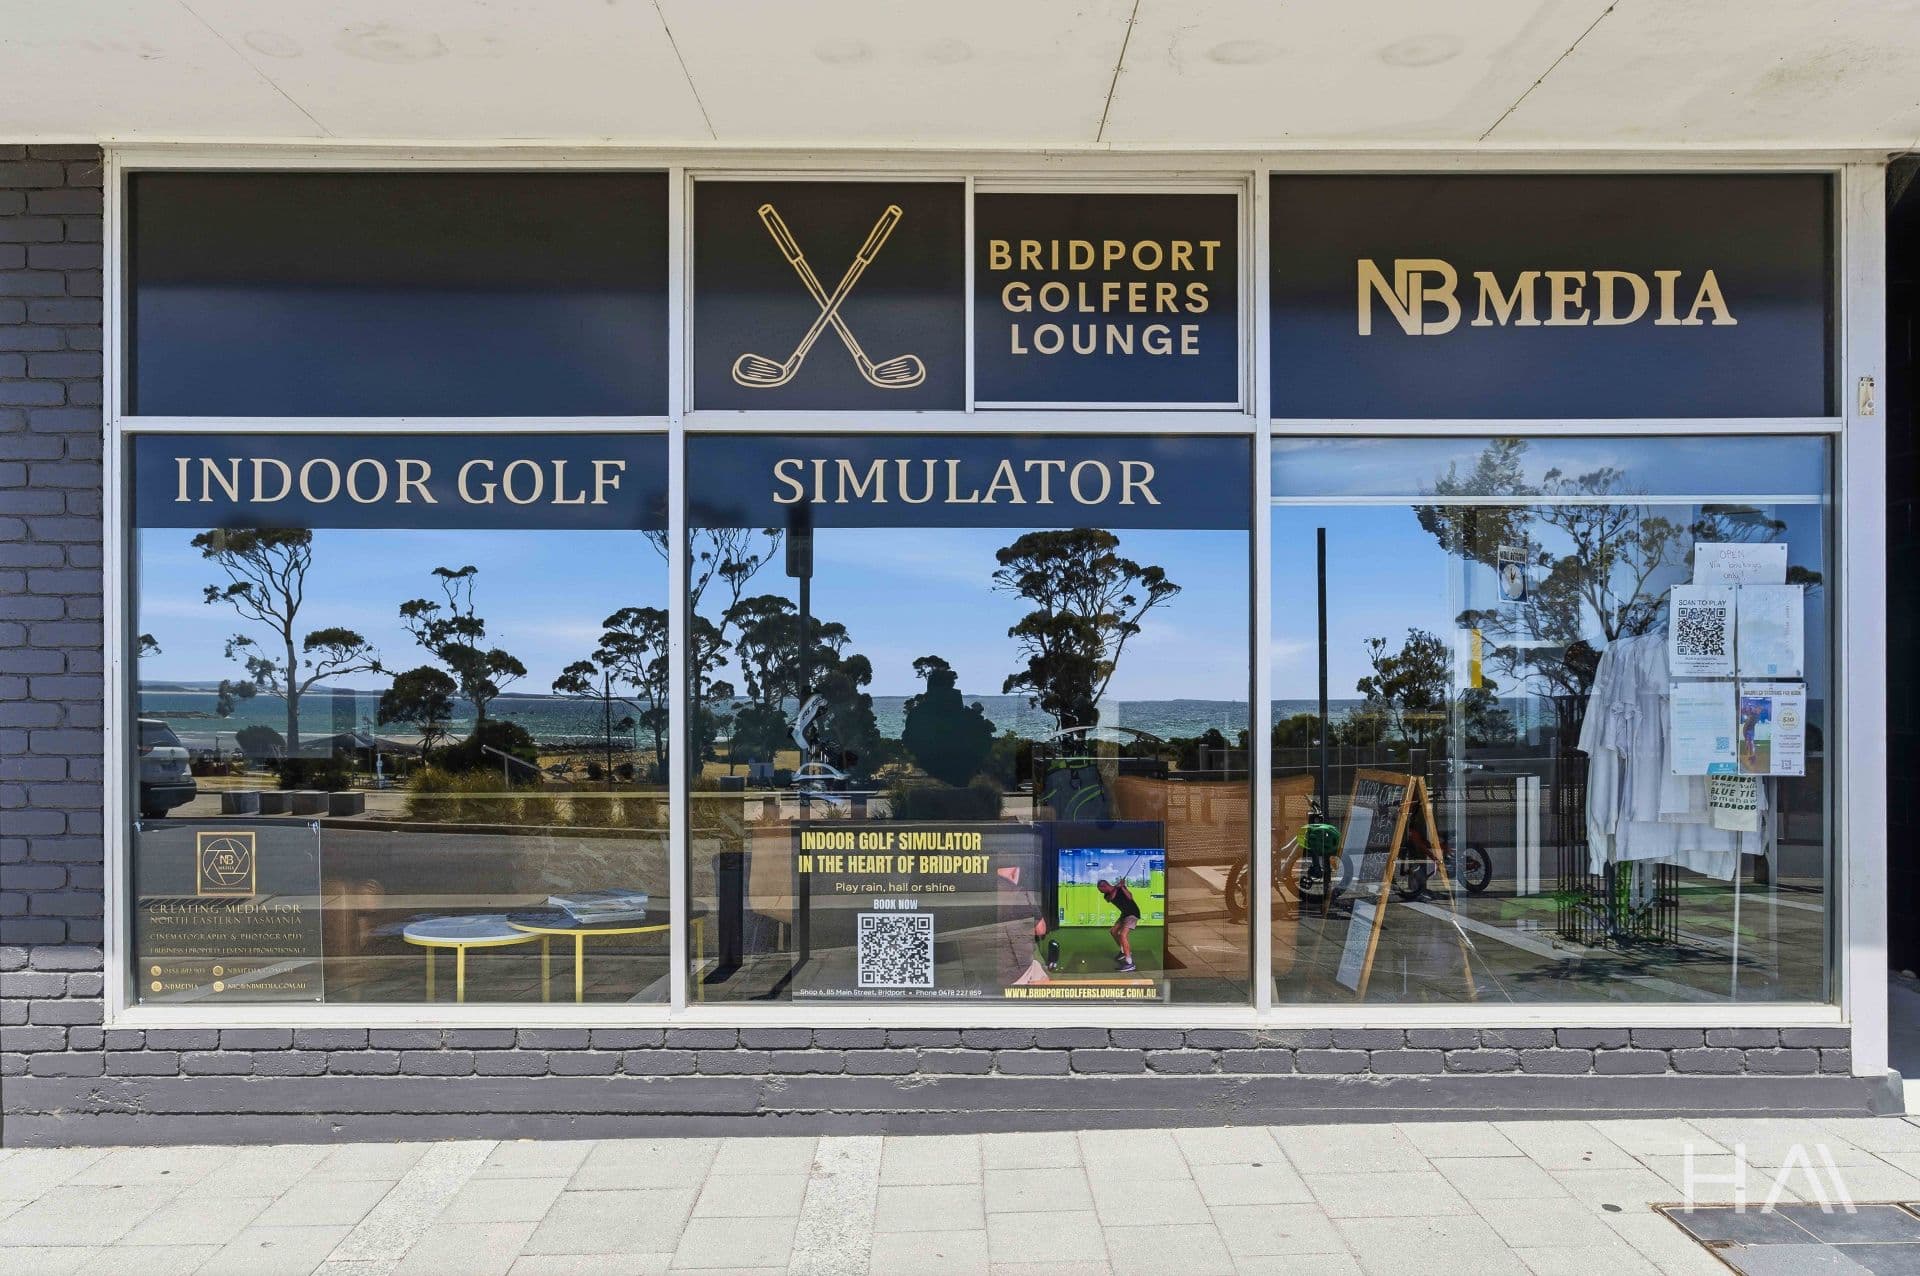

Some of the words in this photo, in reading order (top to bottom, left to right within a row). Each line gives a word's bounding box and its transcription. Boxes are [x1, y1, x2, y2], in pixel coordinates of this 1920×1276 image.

[989, 239, 1221, 271] BRIDPORT
[1001, 281, 1210, 313] GOLFERS
[1357, 258, 1462, 336] NB
[1470, 269, 1738, 327] MEDIA
[1010, 323, 1200, 355] LOUNGE
[174, 457, 438, 504] INDOOR
[457, 458, 627, 505] GOLF
[772, 457, 1161, 505] SIMULATOR
[1719, 550, 1744, 560] OPEN
[1711, 787, 1736, 797] BLUE
[1740, 790, 1756, 798] TIE
[801, 832, 855, 850] INDOOR
[859, 832, 895, 850] GOLF
[899, 832, 982, 851] SIMULATOR
[219, 854, 234, 865] NB
[798, 855, 813, 873] IN
[817, 855, 844, 873] THE
[848, 855, 894, 874] HEART
[897, 855, 915, 874] OF
[919, 855, 990, 874] BRIDPORT
[835, 882, 859, 893] Play
[861, 882, 886, 892] rain,
[888, 882, 909, 892] hail
[911, 884, 923, 892] or
[925, 882, 956, 892] shine
[149, 904, 219, 914] CREATING
[225, 904, 268, 914] MEDIA
[275, 904, 302, 914] FOR
[873, 899, 896, 910] BOOK
[898, 899, 918, 910] NOW
[150, 916, 188, 925] NORTH
[193, 916, 241, 925] EASTERN
[246, 916, 302, 925] TASMANIA
[150, 933, 228, 941] CINEMATOGRAPHY
[230, 933, 237, 941] &
[240, 933, 303, 941] PHOTOGRAPHY
[800, 989, 818, 997] Shop
[878, 989, 906, 997] Bridport
[915, 989, 937, 997] Phone
[1004, 987, 1157, 998] WWW.BRIDPORTGOLFERSLOUNGE.COM.AU
